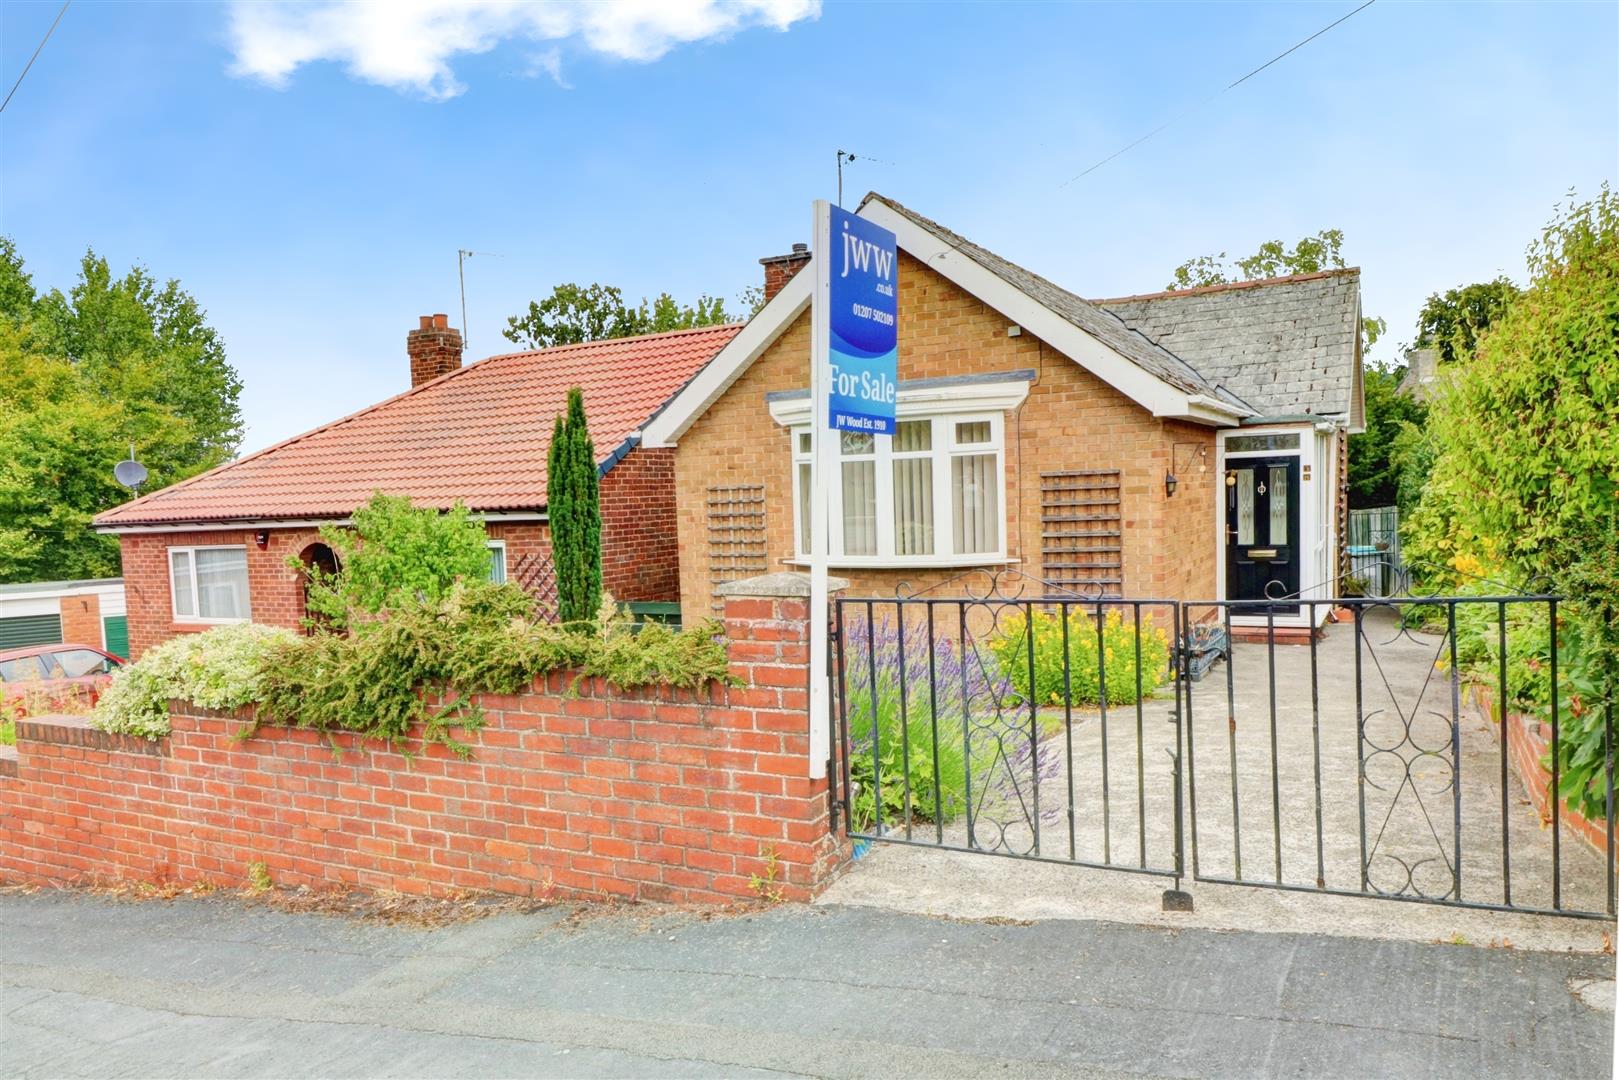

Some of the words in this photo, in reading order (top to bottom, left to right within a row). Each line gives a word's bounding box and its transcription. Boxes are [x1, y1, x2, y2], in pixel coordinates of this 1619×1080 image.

[841, 221, 893, 281] jww
[853, 303, 872, 319] 01207
[873, 309, 894, 327] 502109
[829, 364, 859, 397] For
[861, 371, 894, 403] Sale
[836, 414, 846, 428] JW
[846, 415, 863, 428] Wood
[874, 418, 886, 431] 1910
